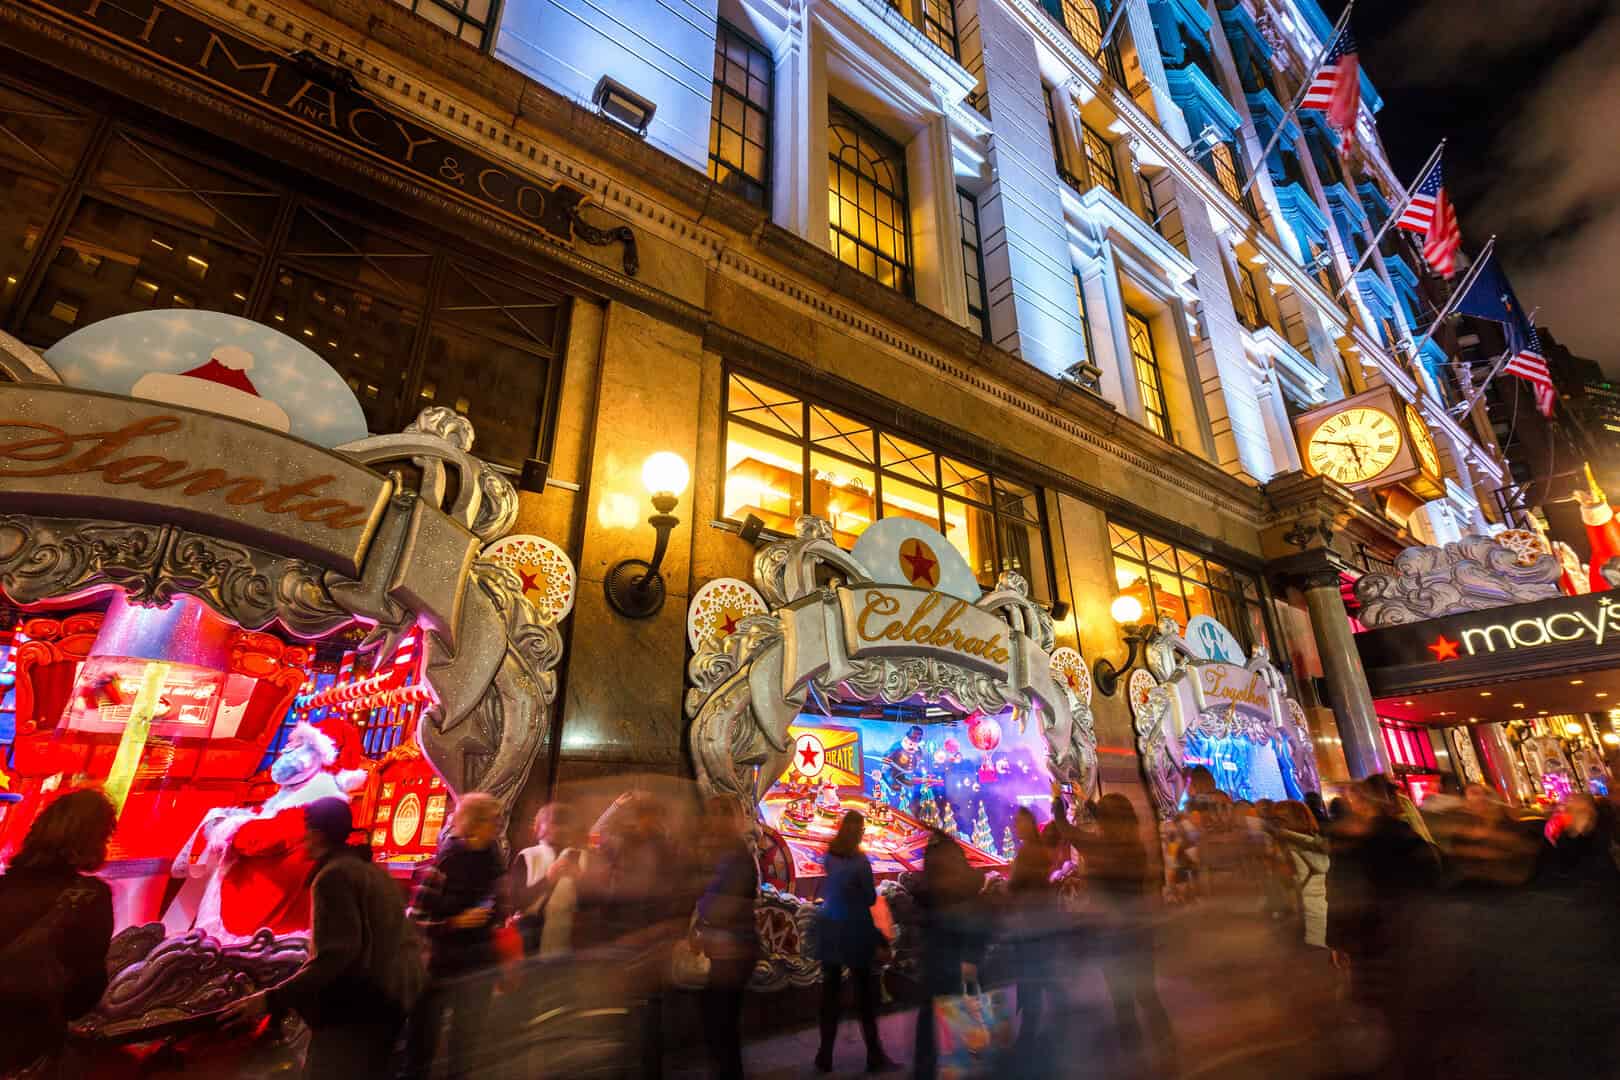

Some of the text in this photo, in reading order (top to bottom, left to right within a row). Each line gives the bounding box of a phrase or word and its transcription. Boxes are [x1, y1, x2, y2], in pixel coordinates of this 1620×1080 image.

[200, 33, 438, 161] MACY
[439, 157, 465, 187] &
[478, 169, 546, 218] CO
[0, 415, 369, 530] Santa
[857, 590, 1010, 665] Celebrate
